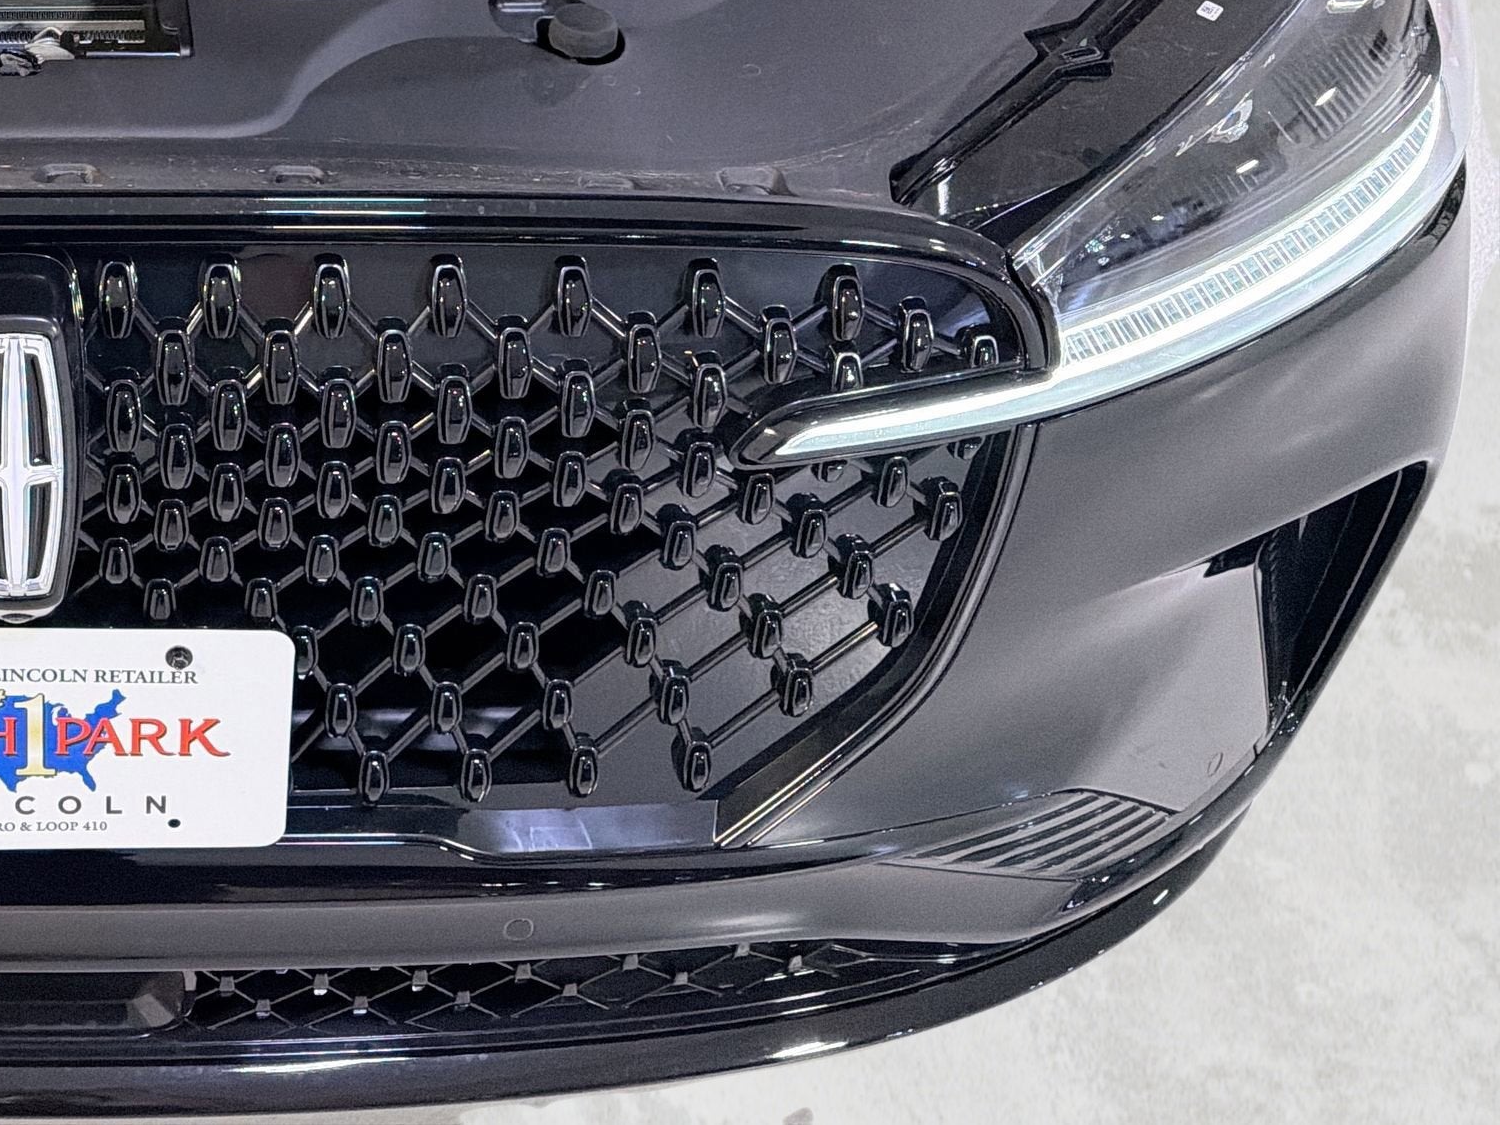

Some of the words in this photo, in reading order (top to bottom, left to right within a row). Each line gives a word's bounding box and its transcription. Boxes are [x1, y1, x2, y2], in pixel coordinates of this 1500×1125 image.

[94, 669, 197, 685] RETAILER
[56, 718, 230, 757] PARK
[20, 821, 32, 833] &
[36, 821, 78, 833] LOOP
[82, 821, 108, 832] 410
